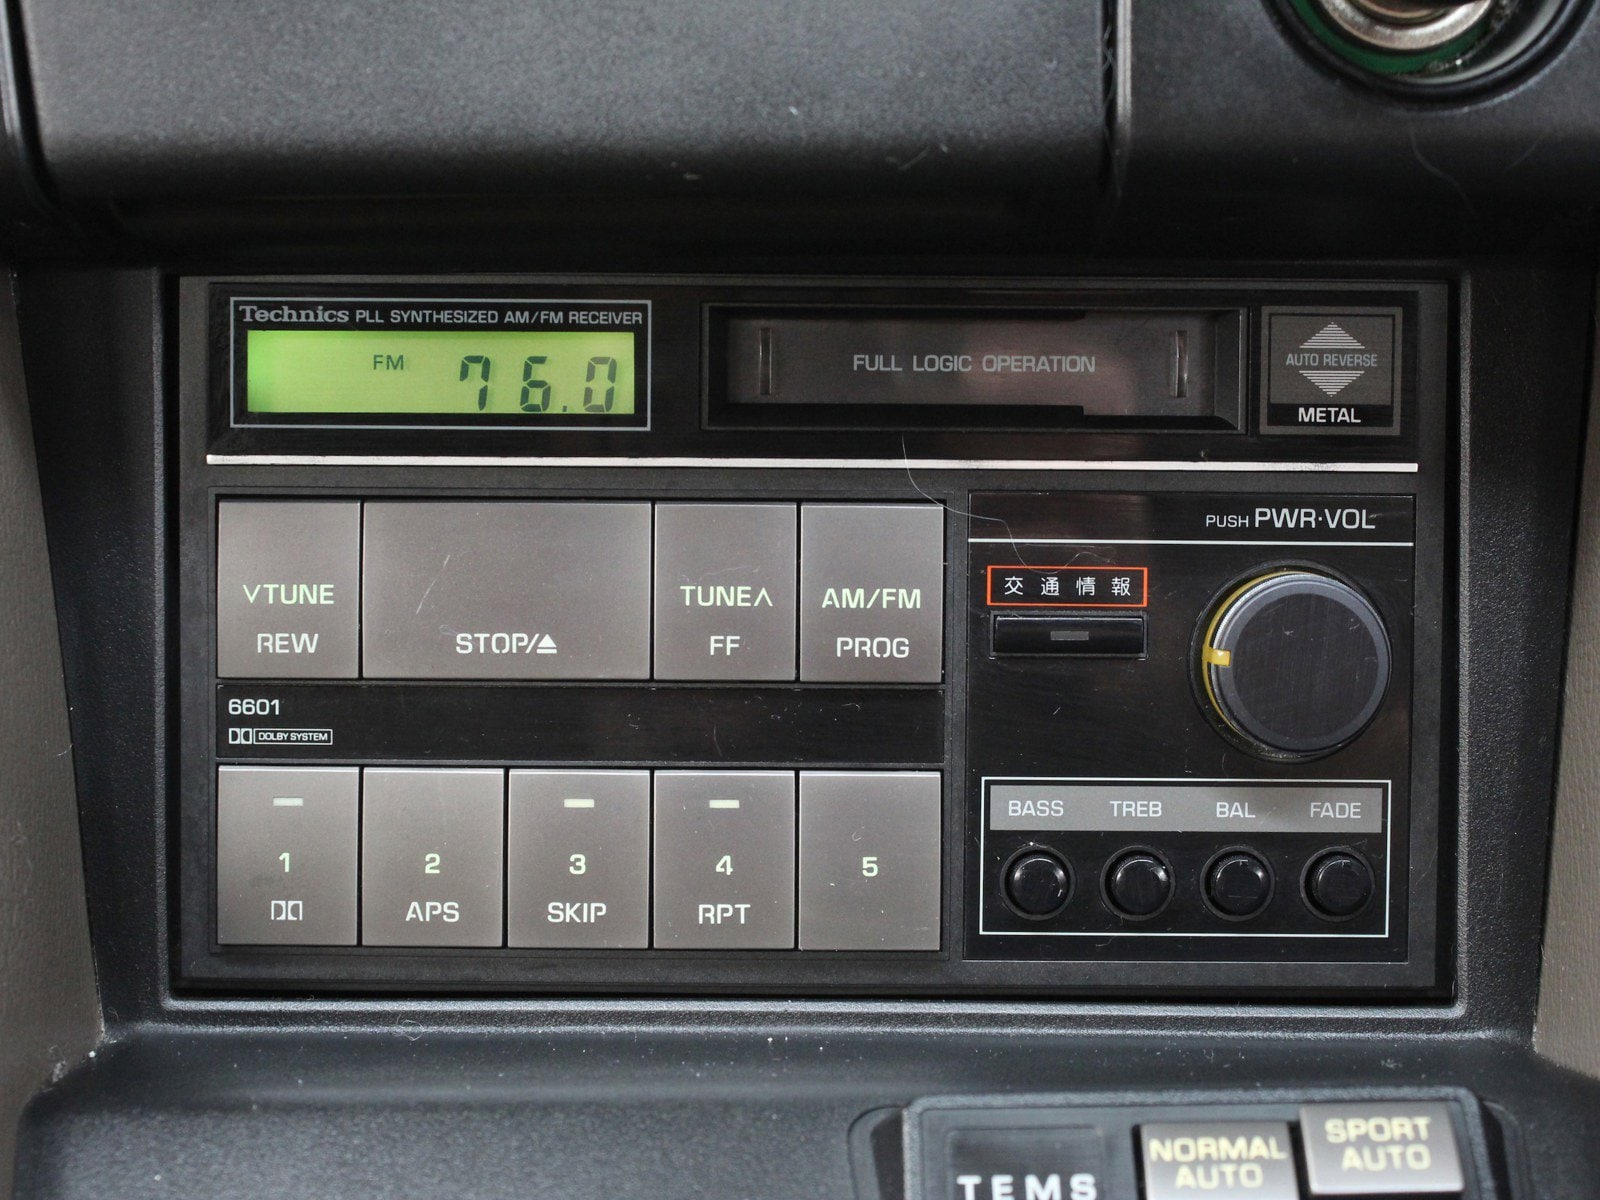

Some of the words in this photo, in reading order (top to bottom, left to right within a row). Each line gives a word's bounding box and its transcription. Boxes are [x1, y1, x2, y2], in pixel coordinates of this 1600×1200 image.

[239, 306, 349, 323] Technics
[356, 310, 385, 322] PLL
[390, 310, 498, 323] SYNTHESIZED
[504, 310, 564, 324] AM/FM
[569, 311, 643, 325] RECEIVER
[373, 355, 404, 370] FM
[853, 355, 903, 372] FULL
[913, 355, 972, 373] LOGIC
[982, 355, 1096, 373] OPERATION
[1285, 353, 1320, 368] AUTO
[1323, 353, 1378, 368] REVERSE
[459, 355, 617, 412] 76.0
[1297, 407, 1361, 423] METAL
[1206, 515, 1249, 528] PUSH
[1004, 576, 1131, 596] 交通情報
[821, 588, 922, 609] AM/FM
[256, 633, 319, 653] REW
[710, 636, 741, 656] FF
[836, 638, 910, 658] PROG
[228, 698, 281, 716] 6601
[258, 732, 288, 741] DOLBY
[290, 732, 328, 741] SYSTEM
[1008, 801, 1064, 817] BASS
[1110, 801, 1162, 817] TREB
[1216, 802, 1255, 818] BAL
[1310, 802, 1361, 818] FADE
[279, 853, 290, 873] 1
[425, 853, 440, 874] 2
[570, 855, 586, 875] 3
[715, 856, 733, 875] 4
[862, 858, 878, 877] 5
[406, 902, 460, 923] APS
[547, 903, 607, 923] SKIP
[699, 905, 751, 924] RPT
[1324, 1117, 1431, 1144] SPORT
[1150, 1137, 1287, 1162] NORMAL
[1341, 1145, 1432, 1171] AUTO
[957, 1174, 1098, 1200] TEMS
[1174, 1164, 1263, 1190] AUTO
